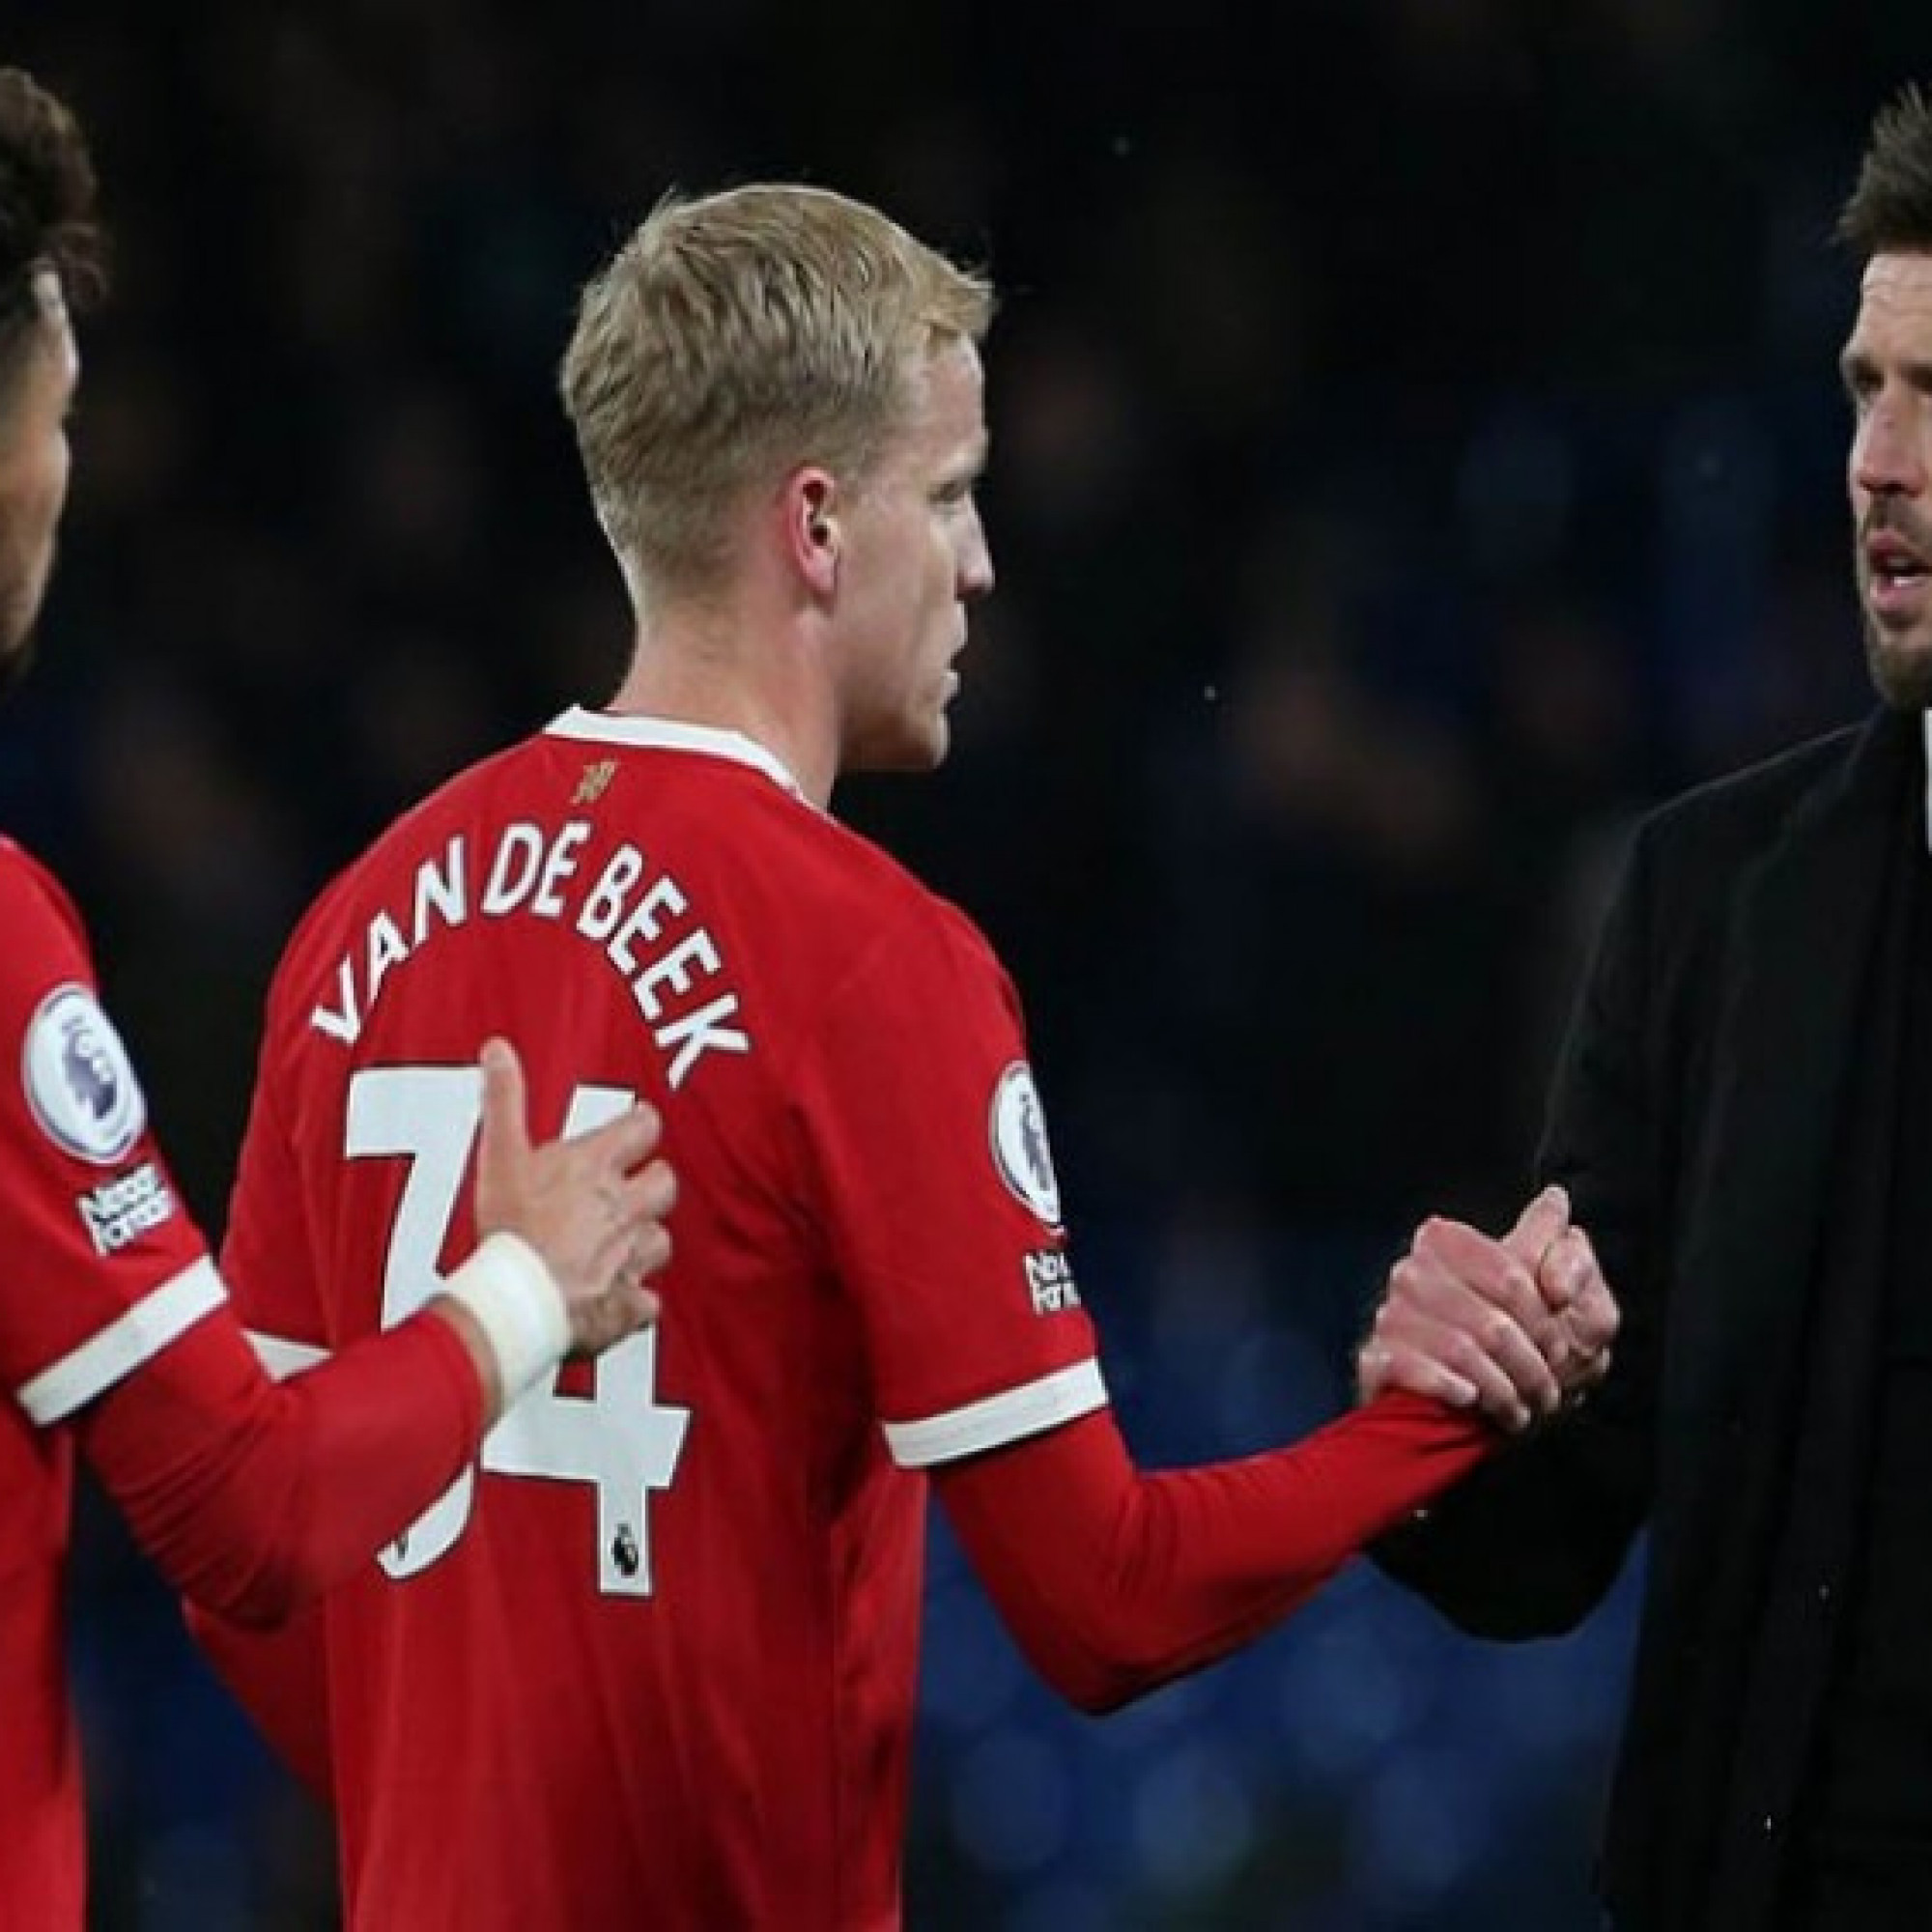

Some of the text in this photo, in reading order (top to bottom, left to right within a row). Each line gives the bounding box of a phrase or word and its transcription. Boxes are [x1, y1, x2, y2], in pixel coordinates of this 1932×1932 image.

[311, 821, 750, 1089] VAN DE BEEK
